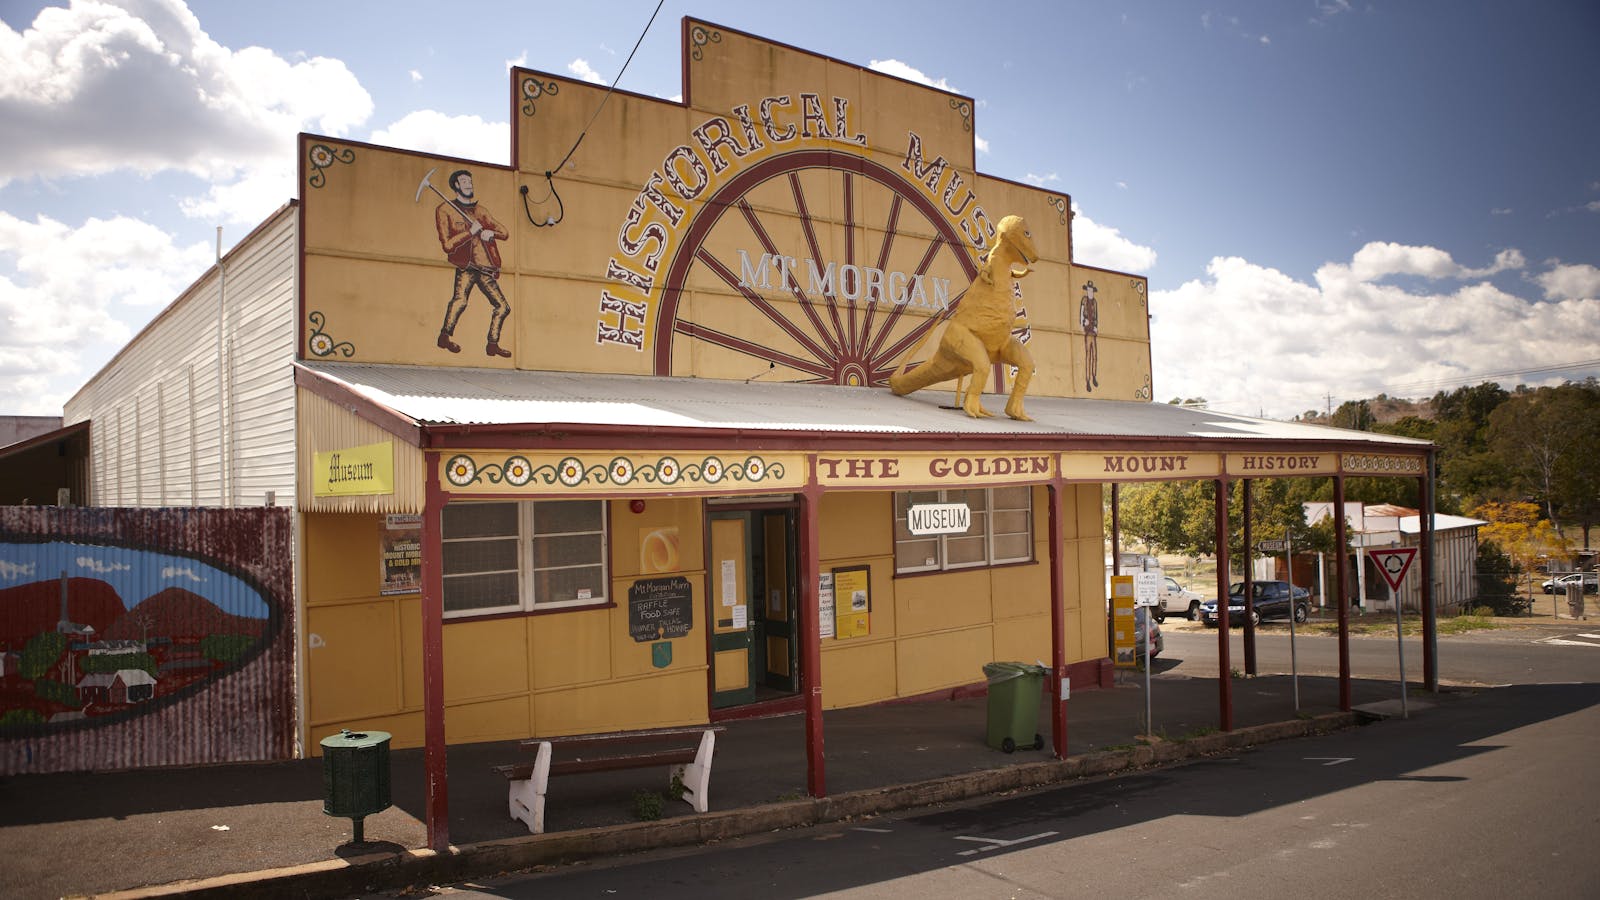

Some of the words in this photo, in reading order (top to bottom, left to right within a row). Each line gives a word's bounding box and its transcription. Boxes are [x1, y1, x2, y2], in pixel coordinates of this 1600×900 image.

[596, 92, 867, 351] HISTORICAL
[736, 249, 800, 293] MT.
[803, 258, 950, 311] MORGAN
[328, 453, 374, 491] Museum
[819, 458, 899, 479] THE
[929, 456, 1050, 478] GOLDEN
[1103, 456, 1188, 473] MOUNT
[1242, 456, 1320, 470] HISTORY
[912, 508, 967, 530] MUSEUM
[393, 543, 420, 552] HISTORIC
[394, 559, 410, 567] GOLD
[637, 600, 668, 612] RAFFLE
[641, 610, 662, 619] FOOD
